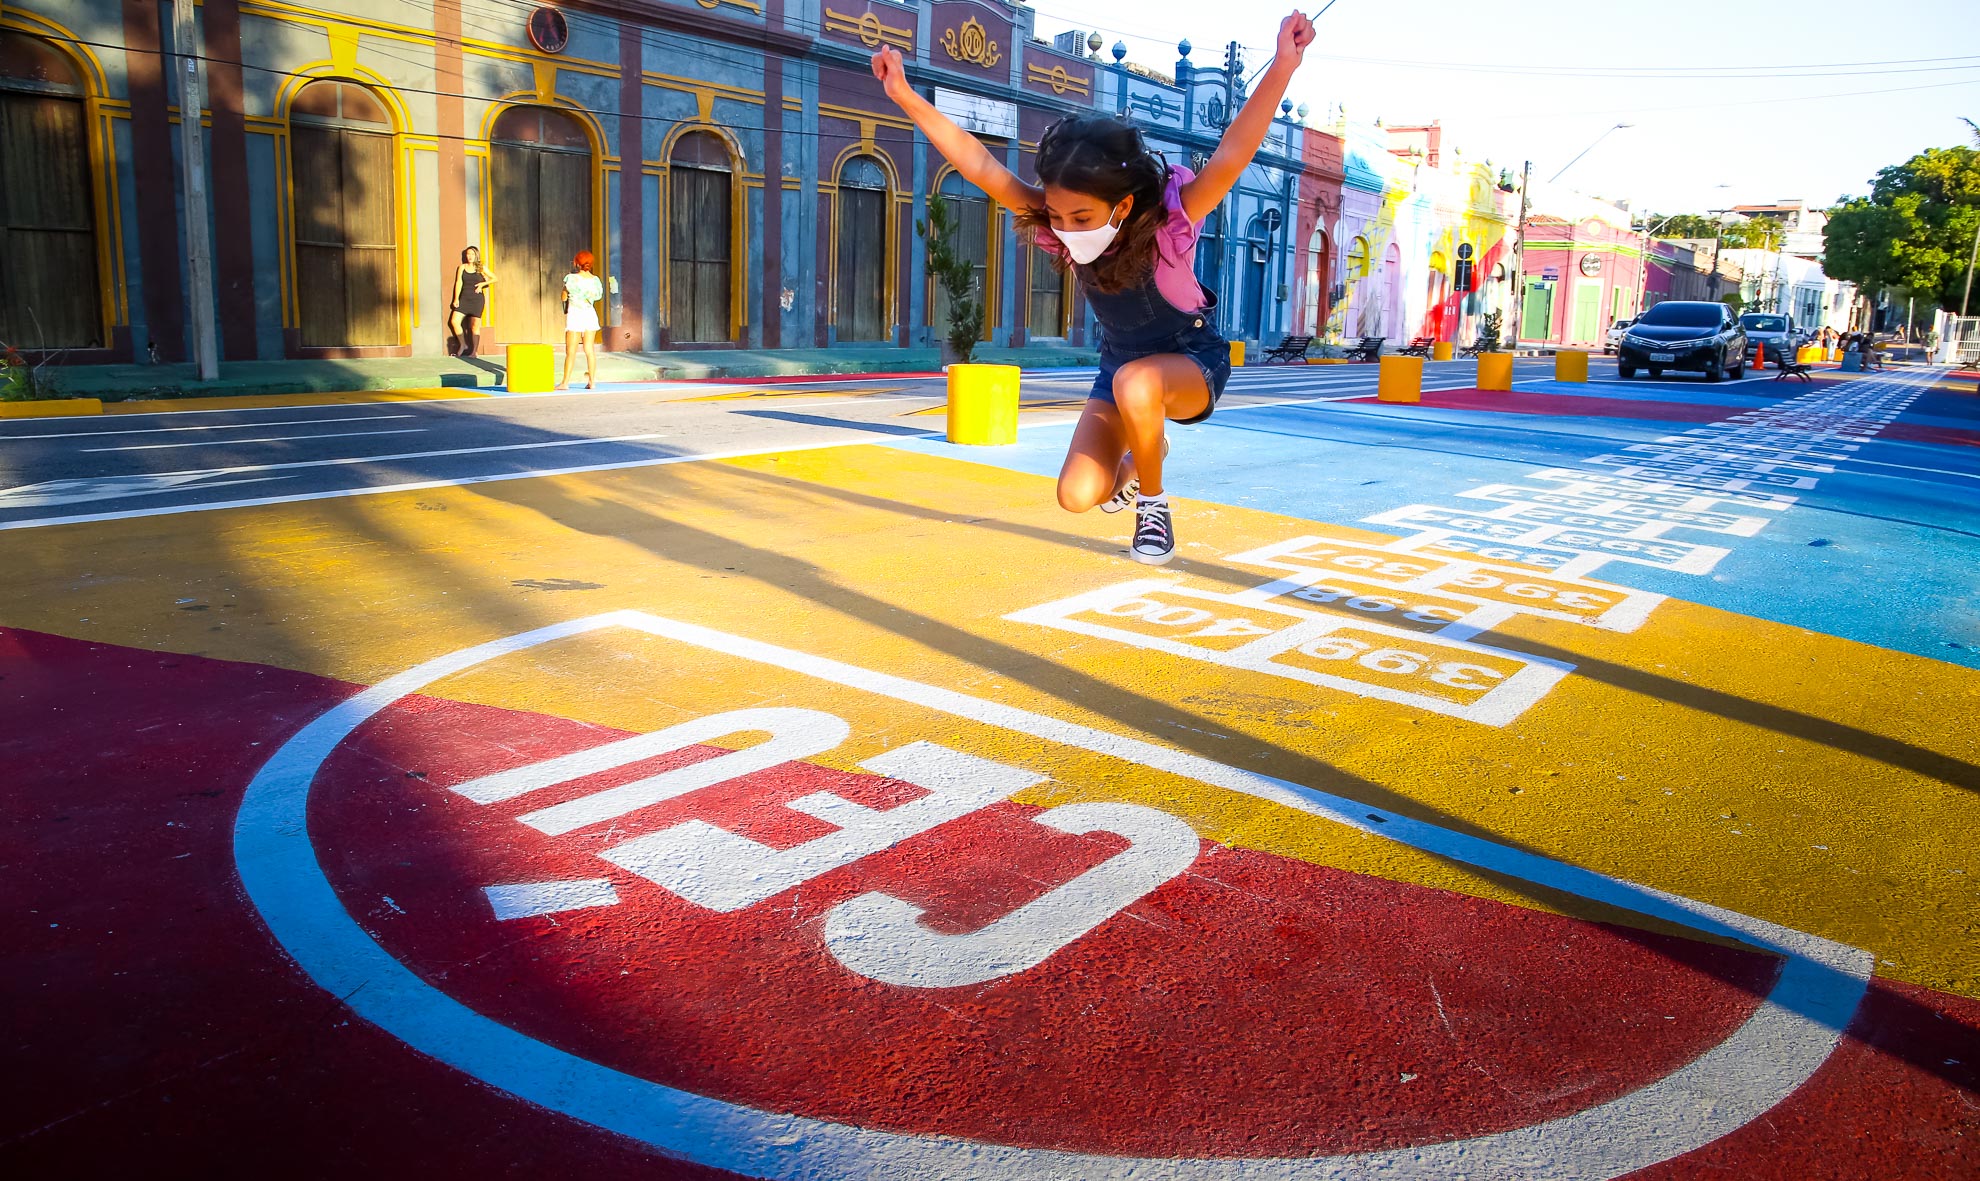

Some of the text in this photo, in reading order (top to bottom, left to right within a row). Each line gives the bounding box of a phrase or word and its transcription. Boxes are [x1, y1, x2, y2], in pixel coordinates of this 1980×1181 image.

[1409, 512, 1534, 538] 394
[1518, 510, 1638, 531] 392
[1619, 506, 1733, 526] 390
[1282, 550, 1428, 577] 397
[1431, 539, 1571, 567] 395
[1293, 584, 1465, 624] 398
[1448, 572, 1611, 610] 396
[1092, 597, 1275, 638] 400
[1297, 636, 1503, 691] 399
